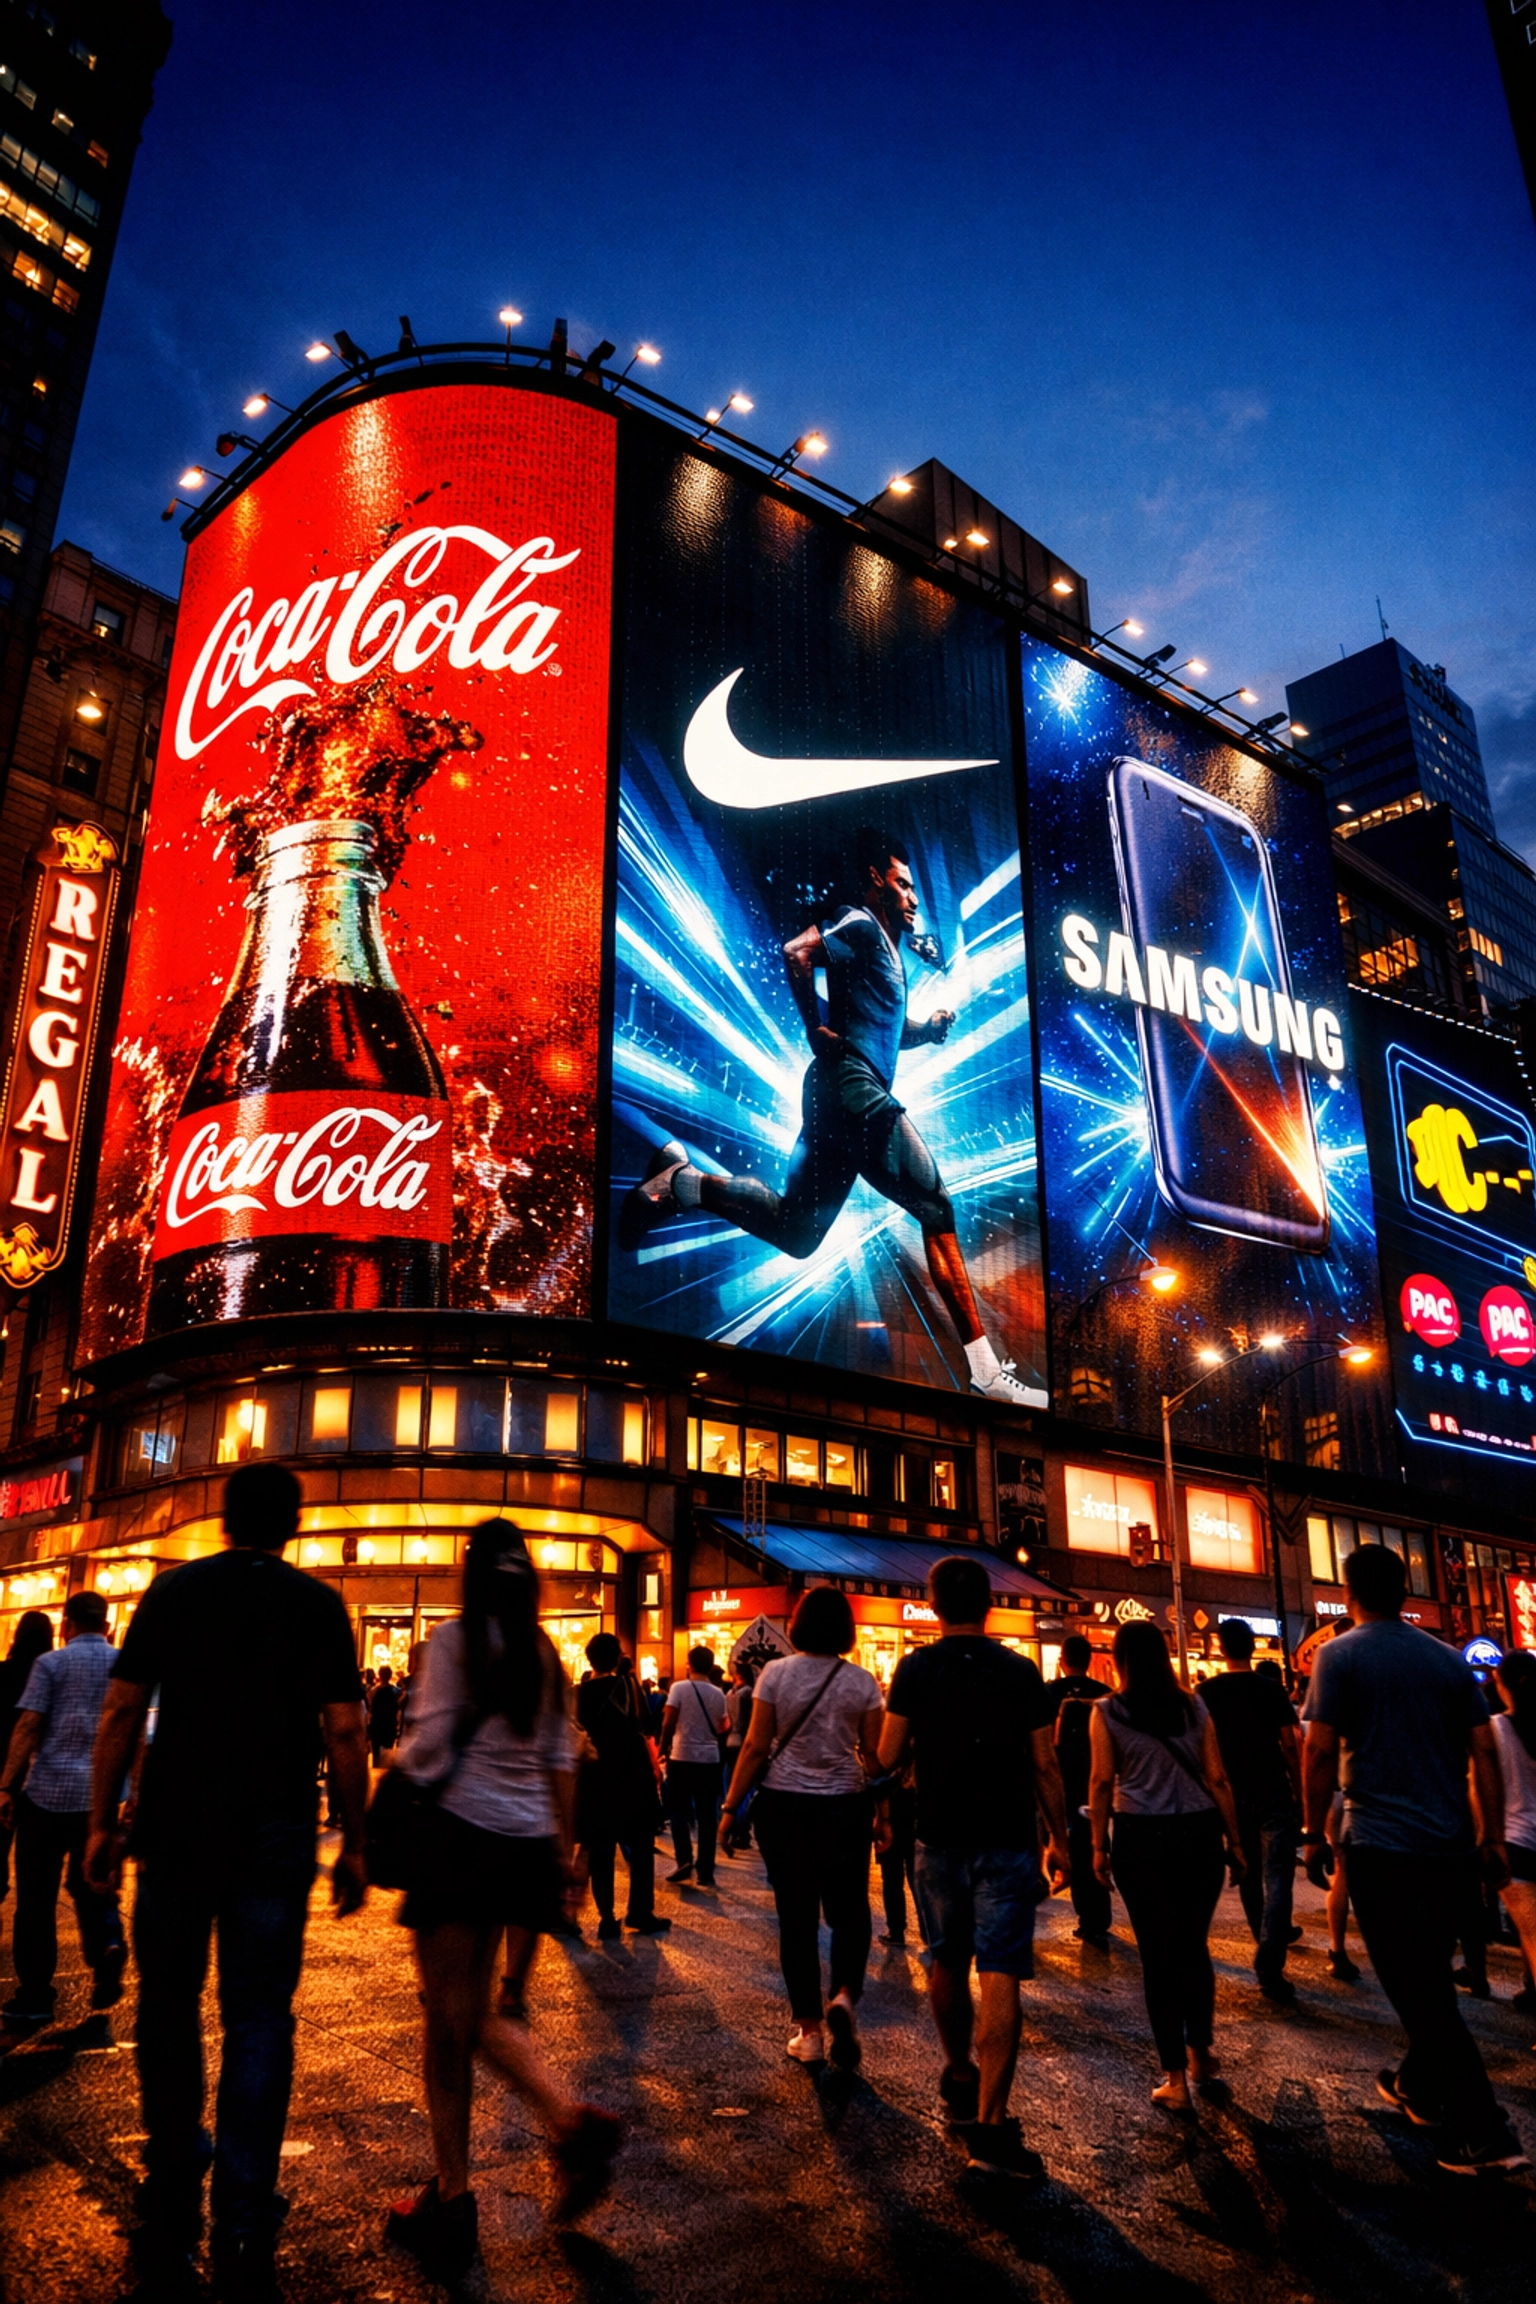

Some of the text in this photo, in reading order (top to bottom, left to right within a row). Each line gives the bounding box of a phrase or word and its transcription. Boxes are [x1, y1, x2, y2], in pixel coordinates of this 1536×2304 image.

[175, 525, 581, 760] Coca-Cola
[11, 878, 97, 1214] REGAL
[1061, 914, 1345, 1070] SAMSUNG
[166, 1107, 443, 1228] Coca-Cola
[1409, 1287, 1453, 1326] PAC
[1487, 1304, 1529, 1342] PAC
